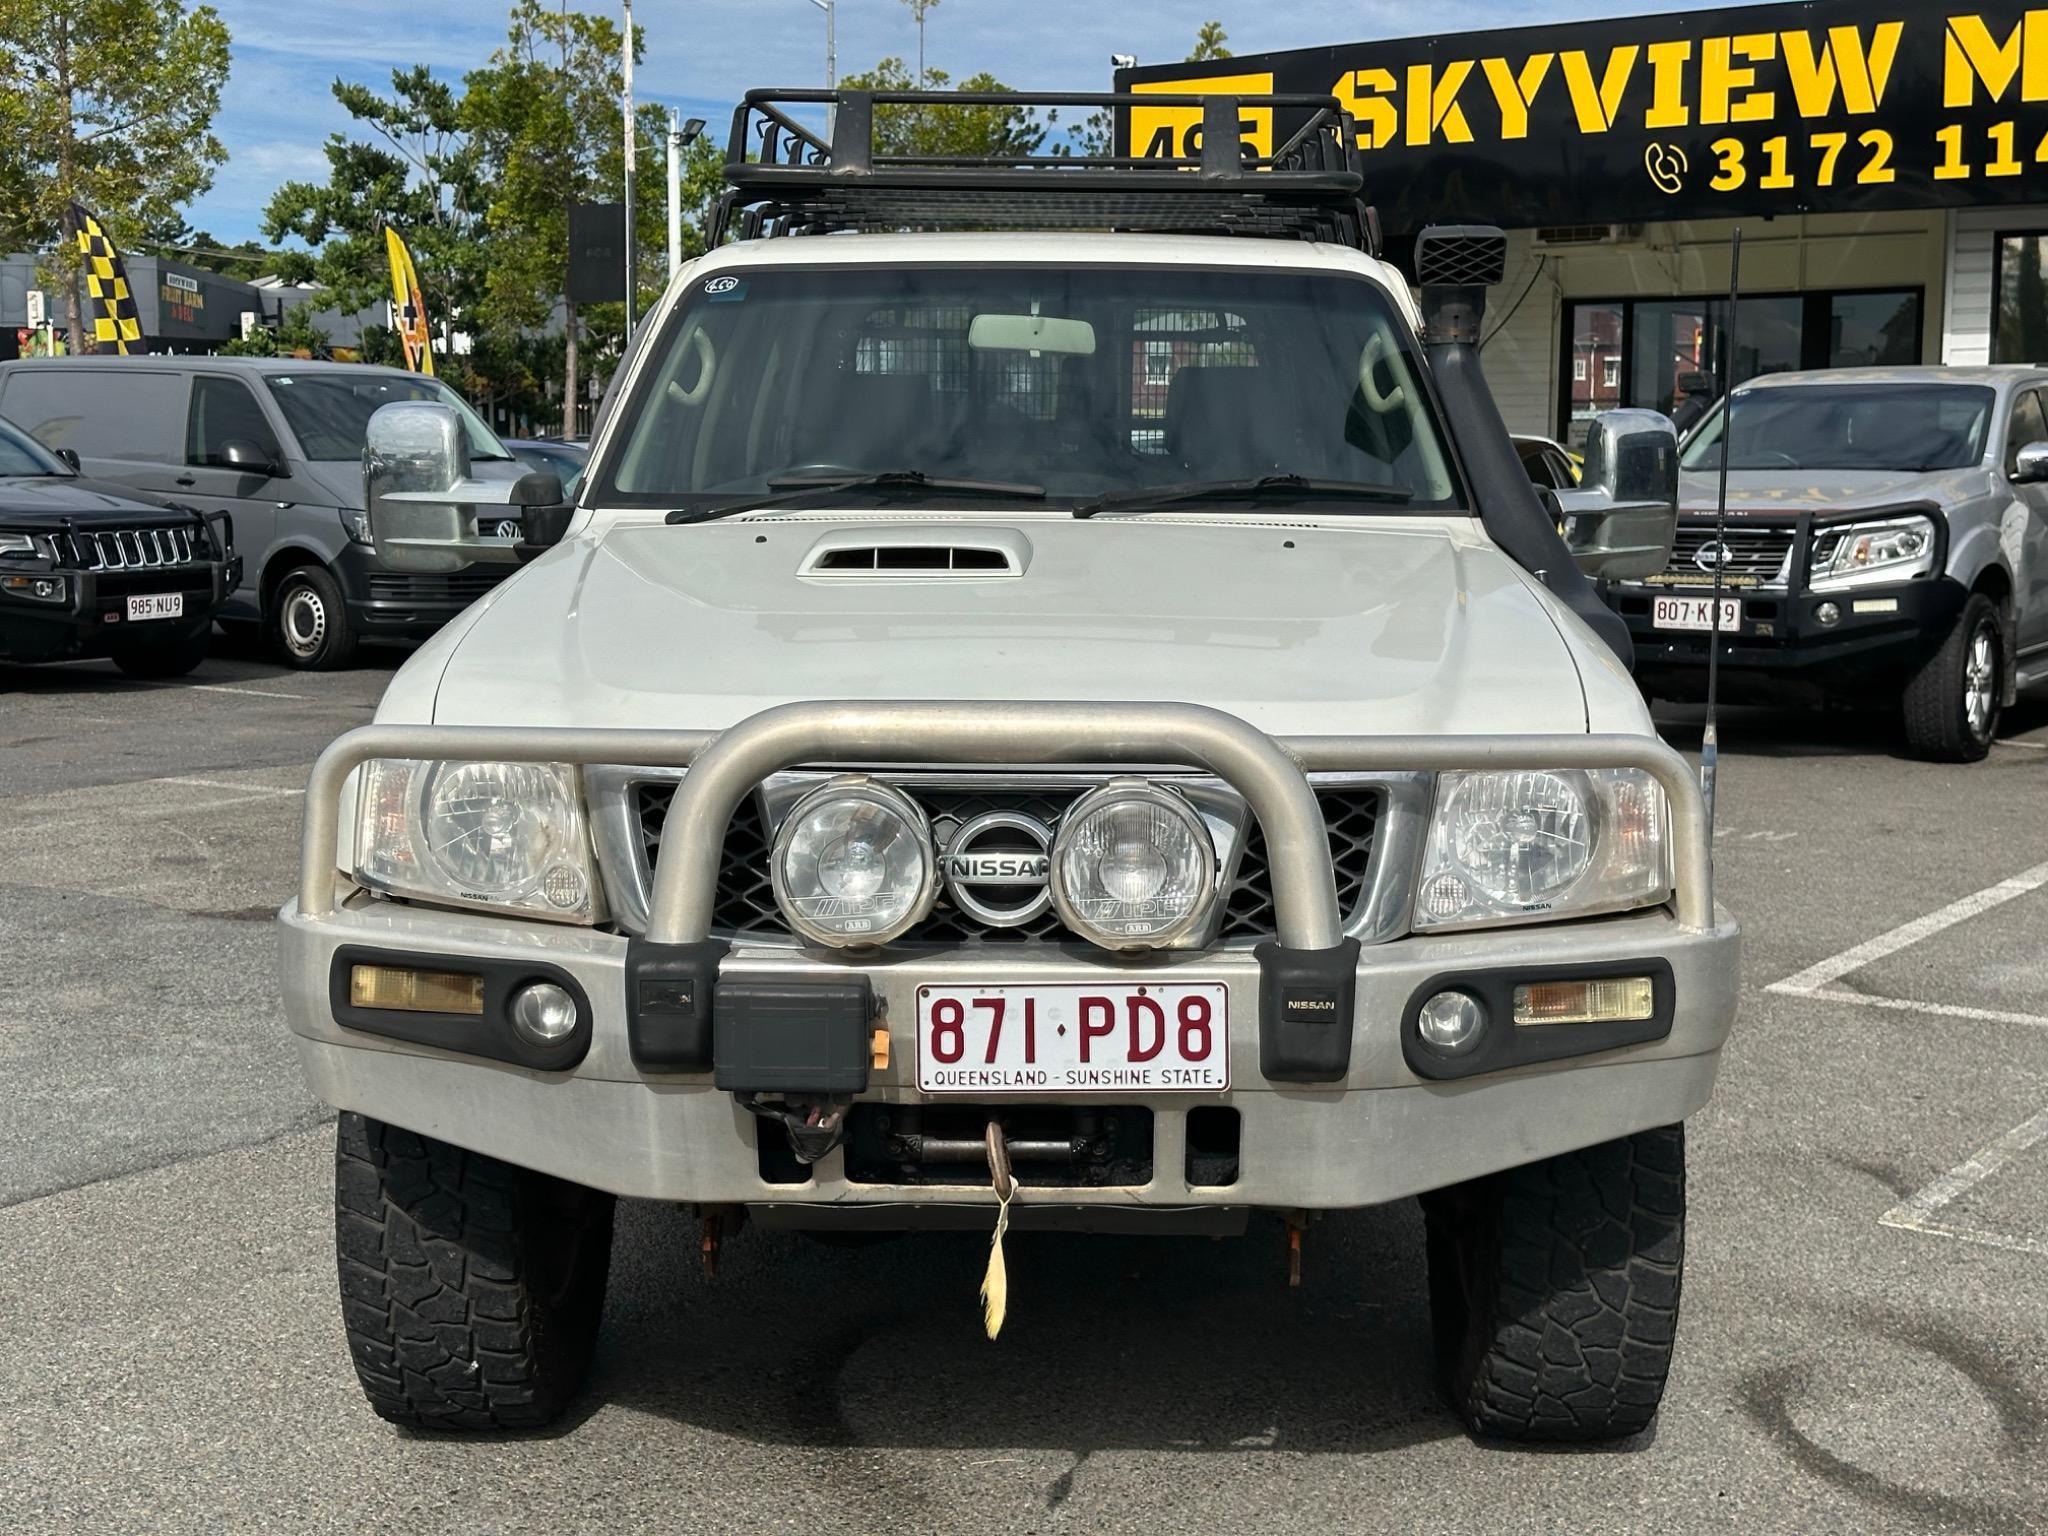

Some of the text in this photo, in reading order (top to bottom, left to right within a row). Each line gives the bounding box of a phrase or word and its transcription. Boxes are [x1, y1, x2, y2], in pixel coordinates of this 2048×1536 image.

[1331, 21, 1904, 150] SKYVIEW
[1709, 129, 1895, 191] 3172
[131, 597, 180, 615] 985 NU9
[1657, 601, 1690, 621] 807
[1522, 903, 1552, 911] NISSAN
[1288, 1001, 1334, 1009] NISSAN
[931, 996, 1211, 1063] 871 PD8
[935, 1071, 1047, 1085] QUEENSLAND
[1066, 1069, 1151, 1084] SUNSHINE
[1162, 1068, 1212, 1084] STATE
